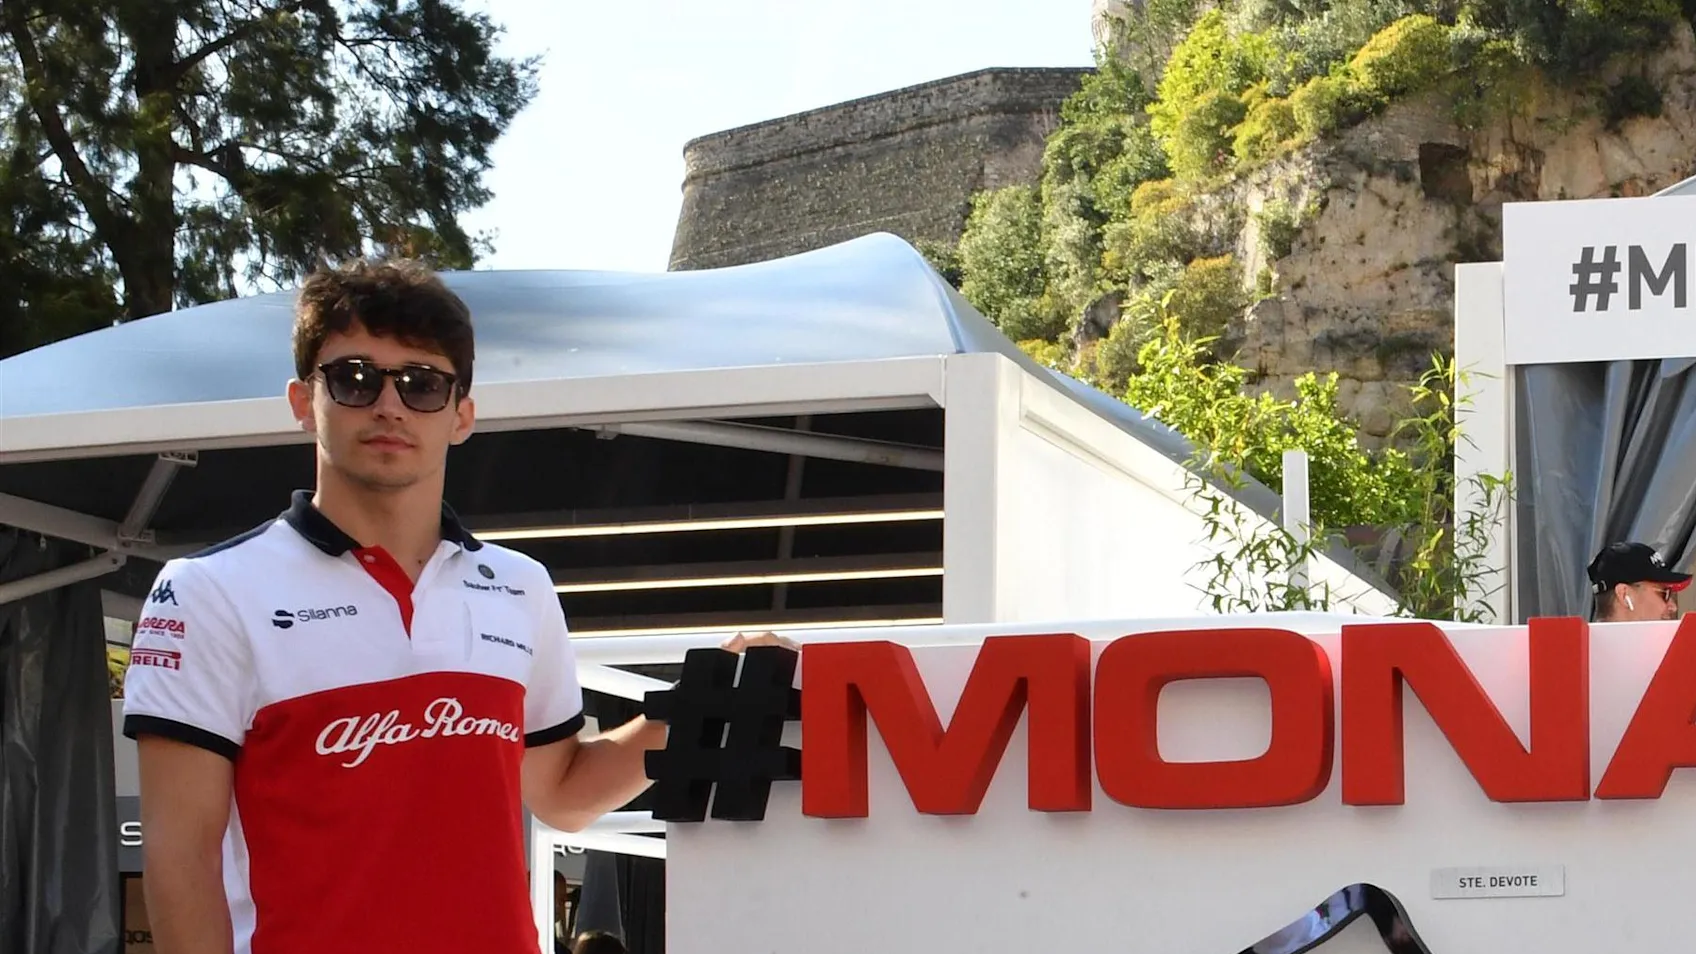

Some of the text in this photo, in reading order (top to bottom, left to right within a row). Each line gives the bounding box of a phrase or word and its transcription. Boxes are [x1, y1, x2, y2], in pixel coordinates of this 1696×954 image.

[297, 604, 359, 622] Silanna
[315, 709, 421, 768] Alfa
[1459, 875, 1538, 888] STE. DEVOTE
